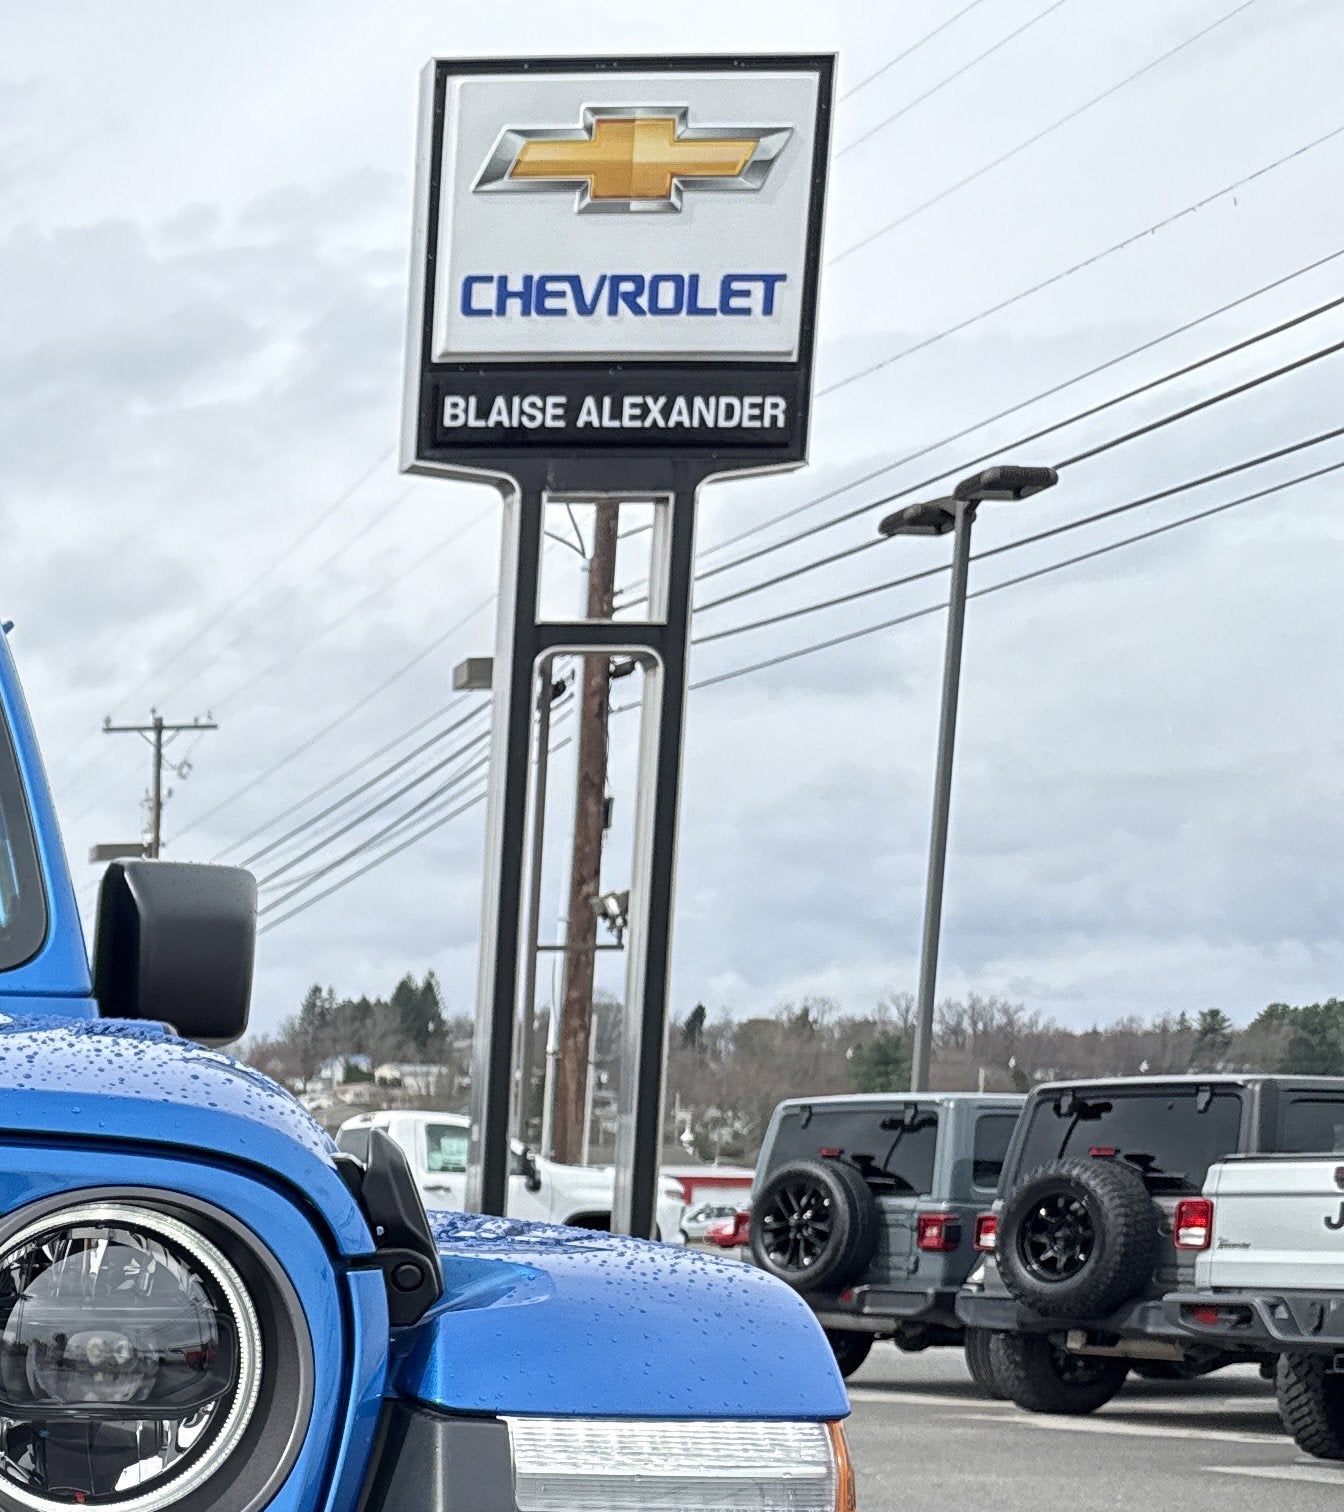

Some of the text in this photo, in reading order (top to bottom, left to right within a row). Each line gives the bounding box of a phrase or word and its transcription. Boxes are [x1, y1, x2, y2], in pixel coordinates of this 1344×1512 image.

[459, 271, 787, 318] CHEVROLET
[443, 395, 787, 429] BLAISE ALEXANDER
